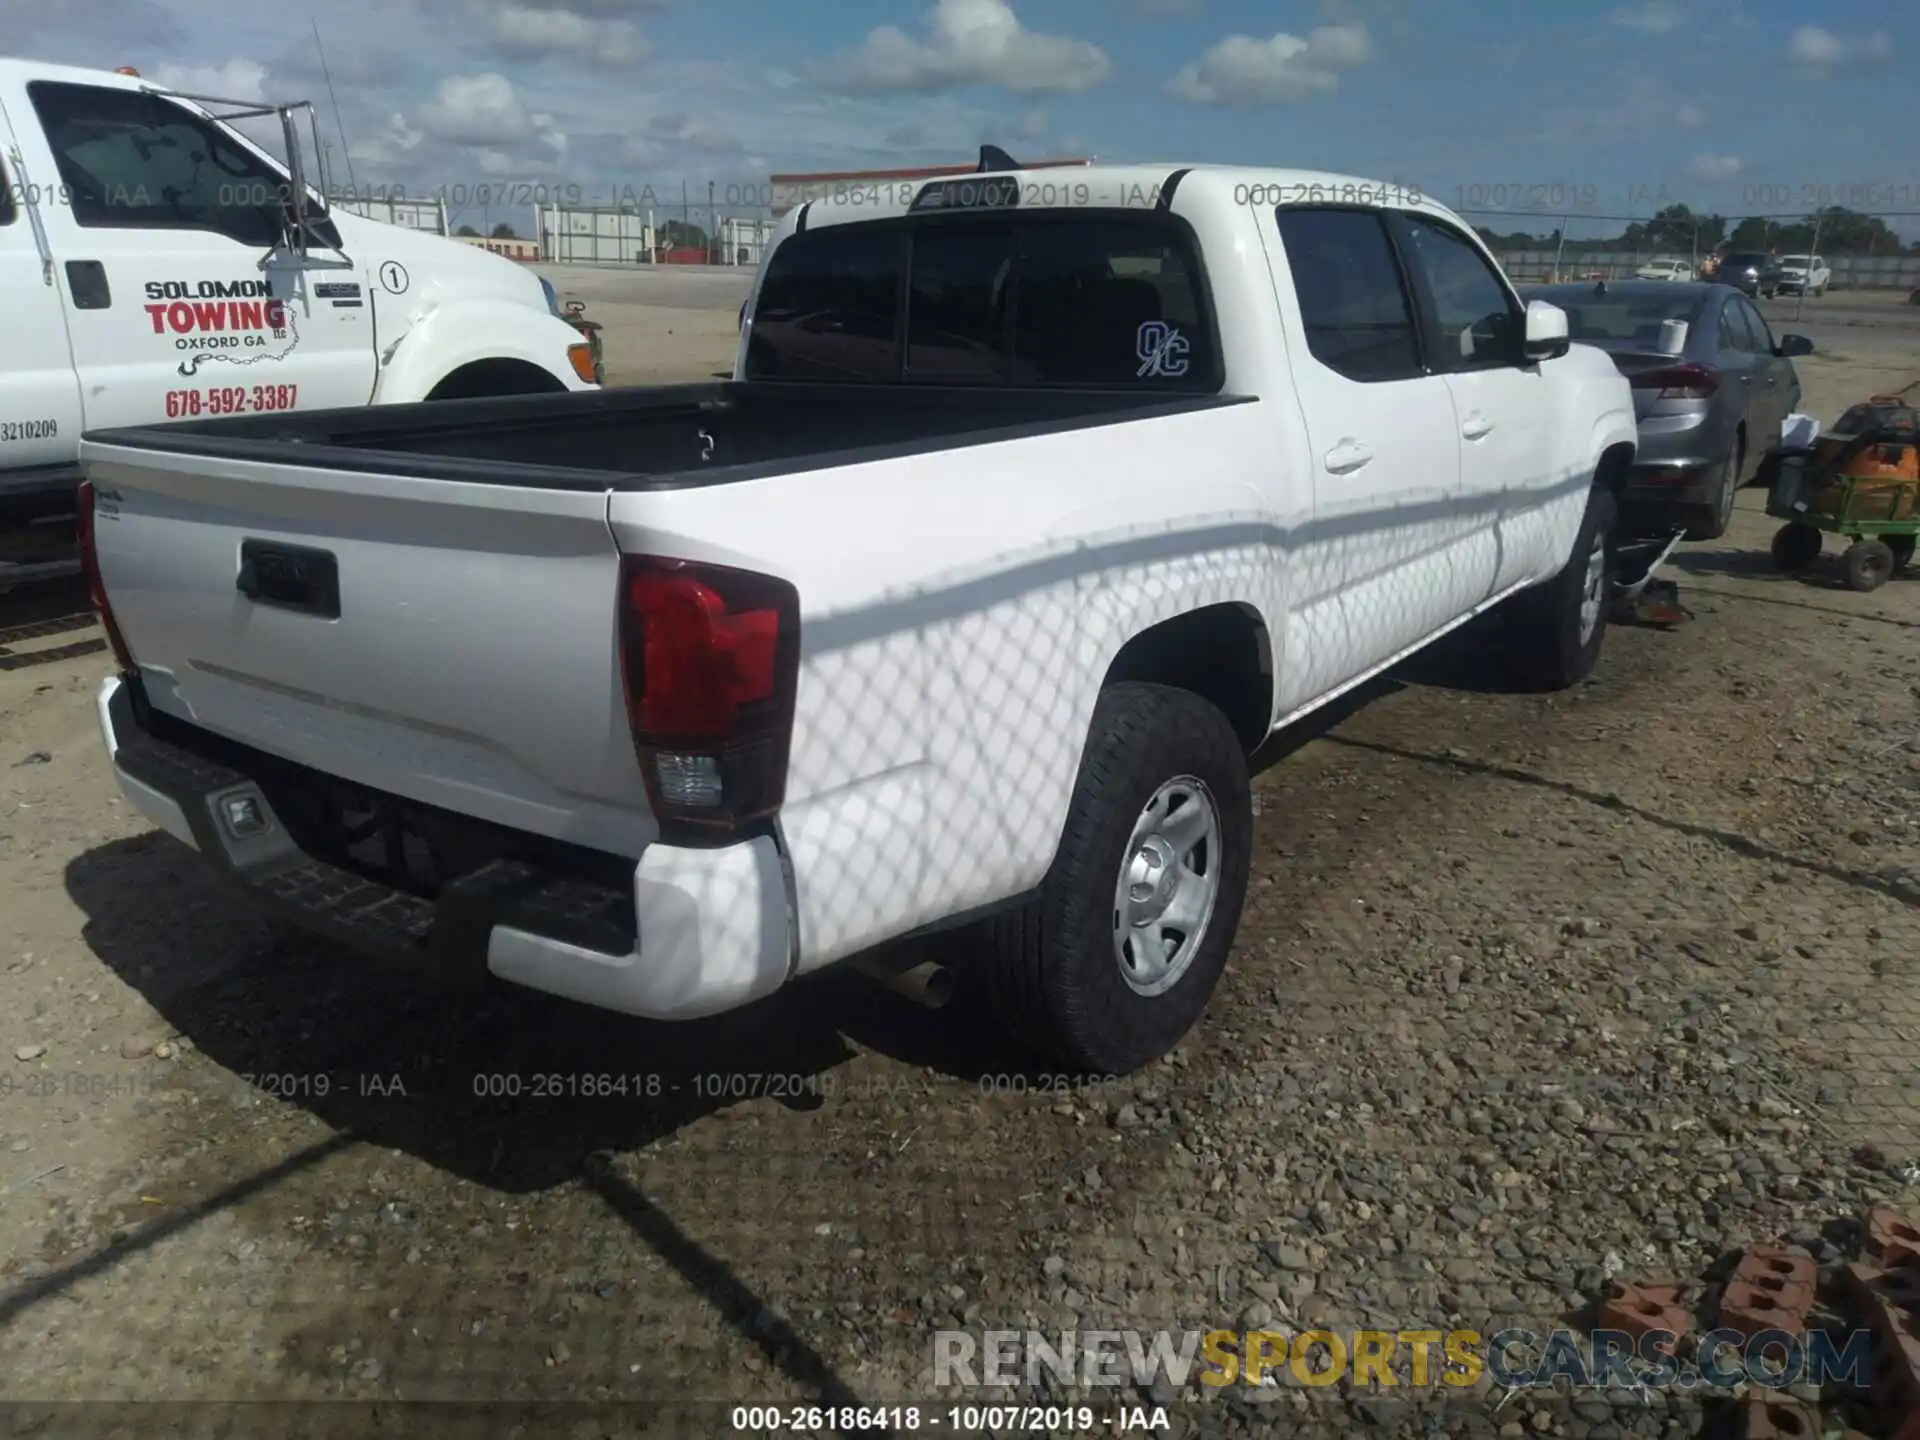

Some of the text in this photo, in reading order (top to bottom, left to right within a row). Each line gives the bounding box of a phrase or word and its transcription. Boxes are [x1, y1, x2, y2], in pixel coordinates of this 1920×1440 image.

[389, 267, 399, 288] 1
[145, 280, 273, 299] SOLOMON
[144, 299, 285, 333] TOWING
[175, 335, 266, 350] OXFORD GA
[165, 384, 298, 418] 678-592-3387
